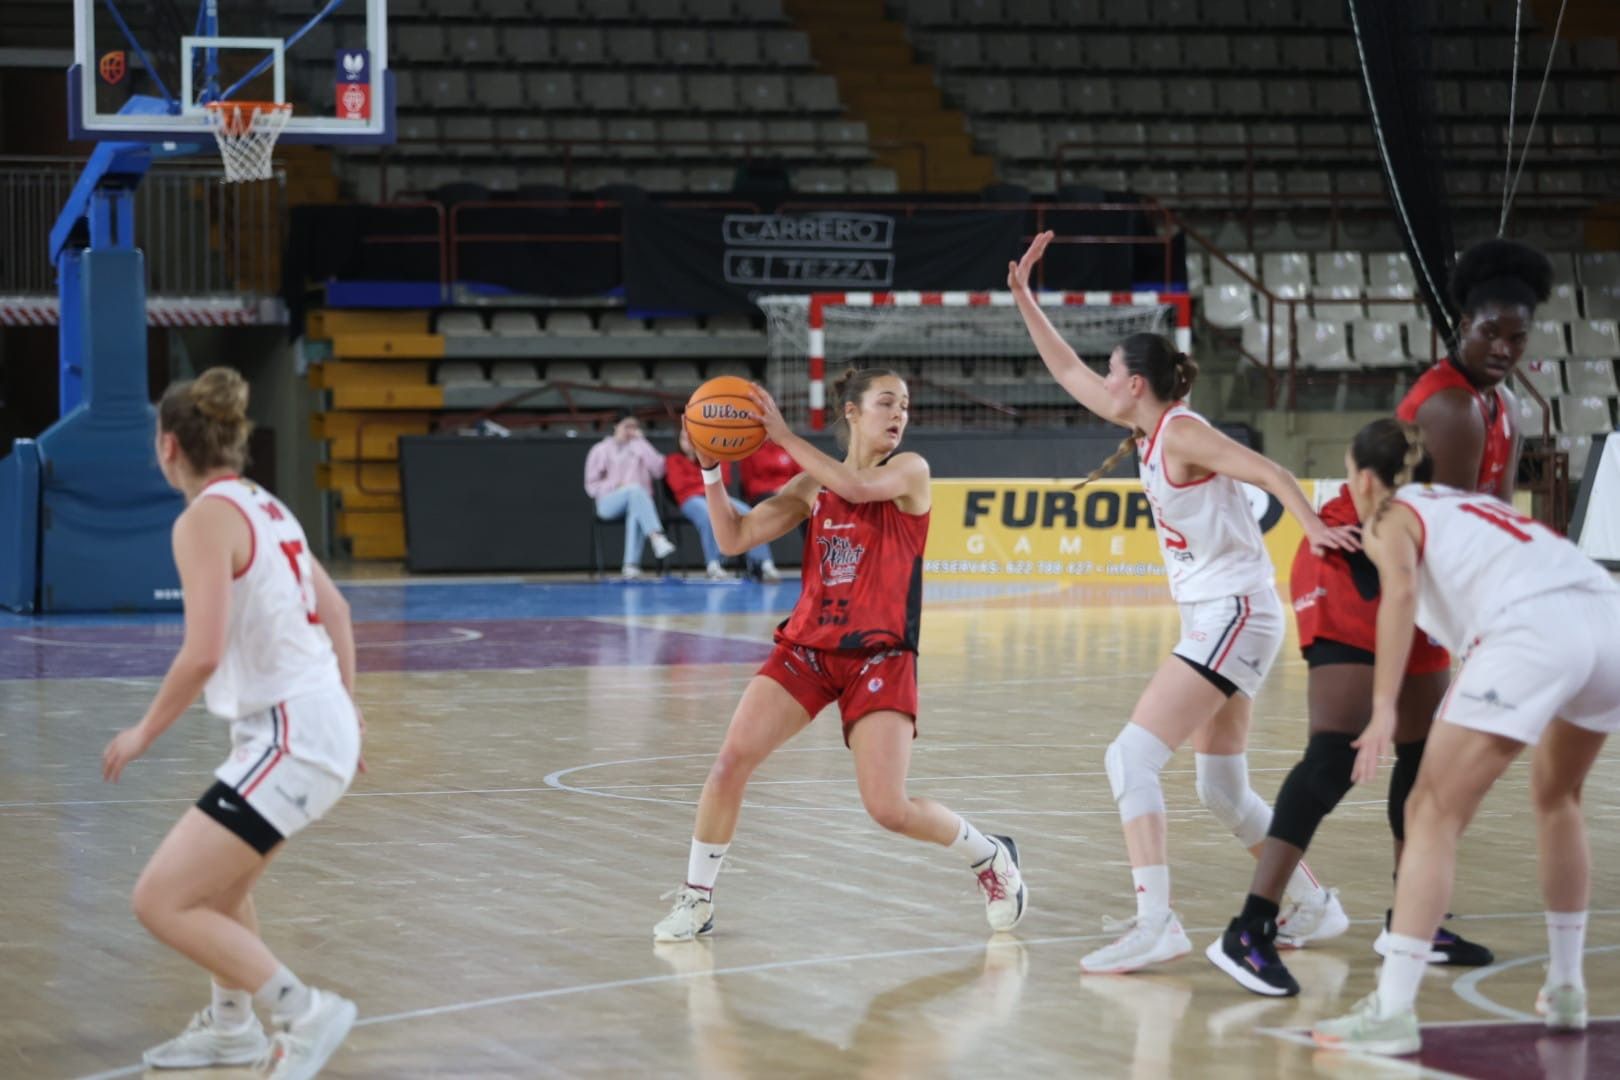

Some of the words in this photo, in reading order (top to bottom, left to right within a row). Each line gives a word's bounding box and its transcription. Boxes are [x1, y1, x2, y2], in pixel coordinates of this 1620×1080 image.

[736, 219, 878, 242] CARRERO
[736, 258, 753, 279] &
[782, 259, 877, 281] TEZZA
[703, 404, 754, 419] Wilso
[966, 534, 1125, 555] GAME
